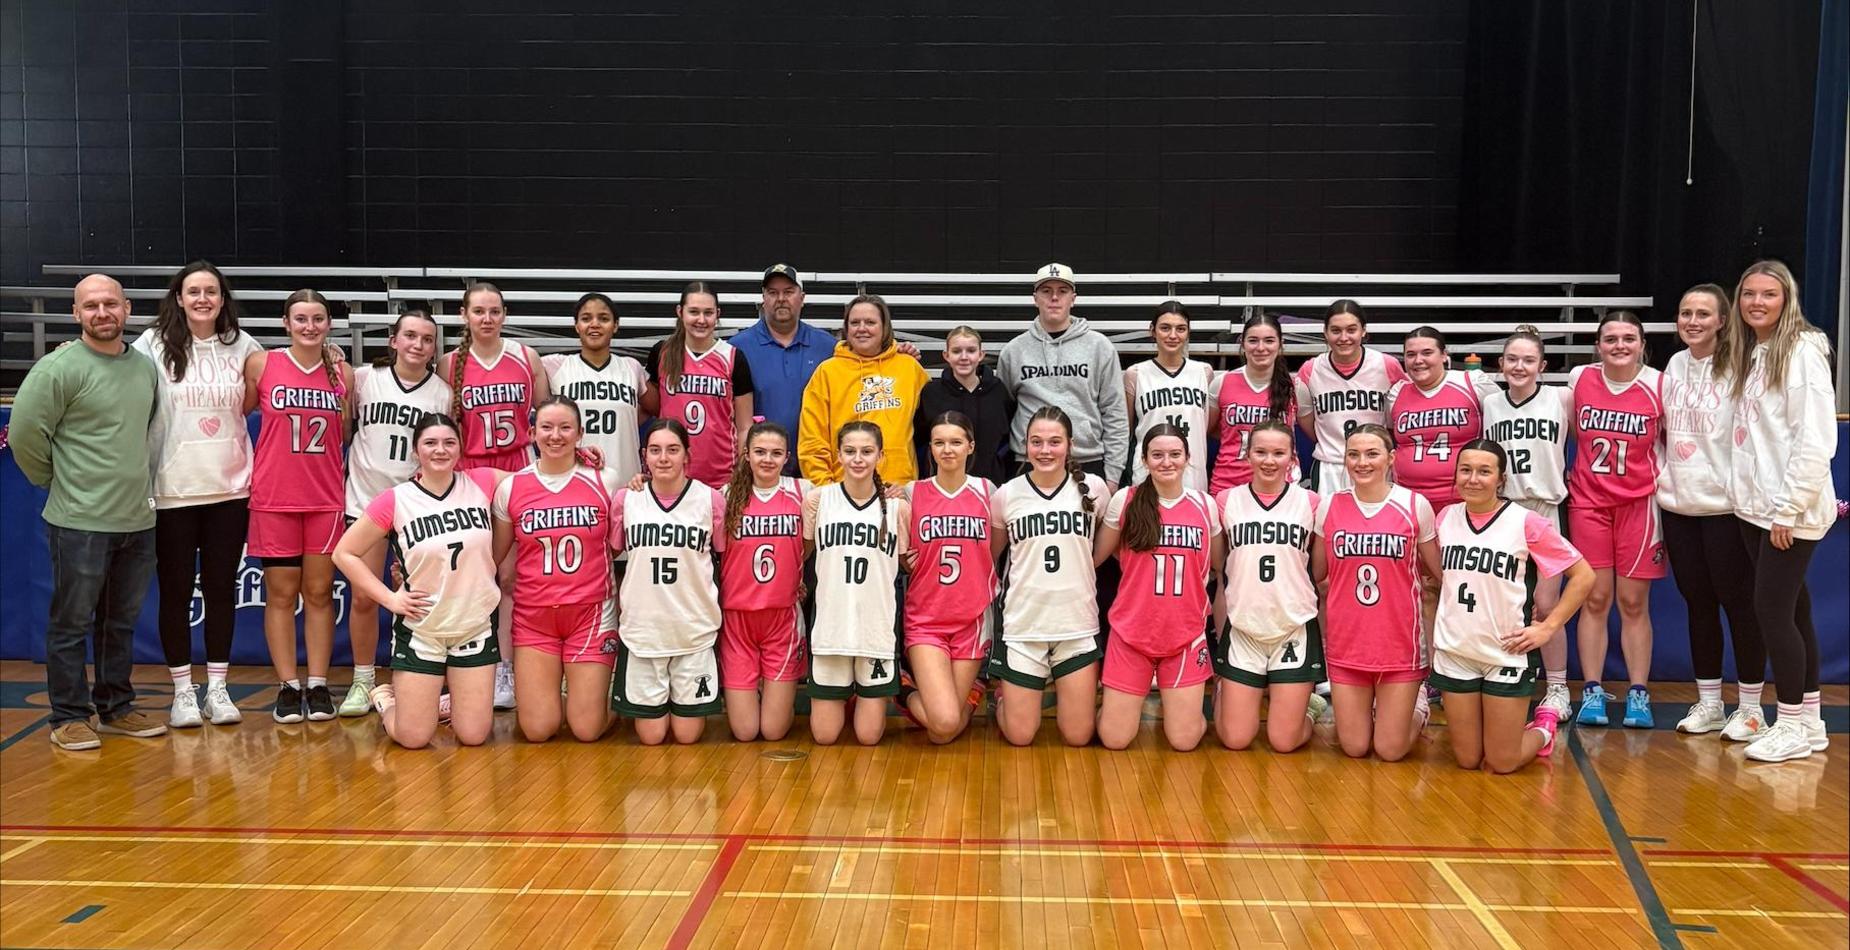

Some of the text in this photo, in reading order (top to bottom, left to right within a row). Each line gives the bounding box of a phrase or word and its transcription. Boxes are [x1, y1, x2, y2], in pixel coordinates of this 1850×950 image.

[1020, 363, 1089, 381] SPALDING
[461, 382, 526, 410] GRIFFINS
[855, 397, 902, 413] GRIFFINS
[1140, 387, 1207, 416] LUMSDEN
[363, 402, 431, 429] LUMSD
[480, 409, 517, 449] 15
[585, 409, 616, 434] 20
[684, 400, 707, 435] 9
[1225, 402, 1288, 427] GRIFF
[1397, 408, 1469, 434] GRIFFINS
[1579, 405, 1650, 437] GRIFFINS
[287, 413, 328, 454] 12
[389, 434, 408, 461] 11
[1237, 429, 1250, 460] 1
[1410, 432, 1453, 462] 14
[1507, 449, 1532, 474] 12
[1590, 437, 1629, 476] 21
[402, 506, 491, 549] LUMSDEN
[520, 505, 600, 534] GRIFFINS
[919, 514, 986, 542] GRIFFINS
[1010, 510, 1092, 544] LUMSDEN
[626, 522, 708, 553] LUMSDEN
[1159, 524, 1203, 551] IFFINS
[1227, 521, 1309, 552] LUMSDEN
[1331, 530, 1407, 561] GRIFFINS
[447, 541, 463, 571] 7
[538, 534, 583, 576] 10
[752, 544, 776, 583] 6
[844, 556, 868, 584] 10
[938, 545, 962, 585] 5
[1044, 545, 1061, 573] 9
[1259, 555, 1276, 583] 6
[1441, 545, 1520, 583] UMSDEN
[651, 557, 678, 584] 15
[1152, 553, 1185, 597] 11
[1355, 563, 1382, 606] 8
[1458, 582, 1476, 613] 4
